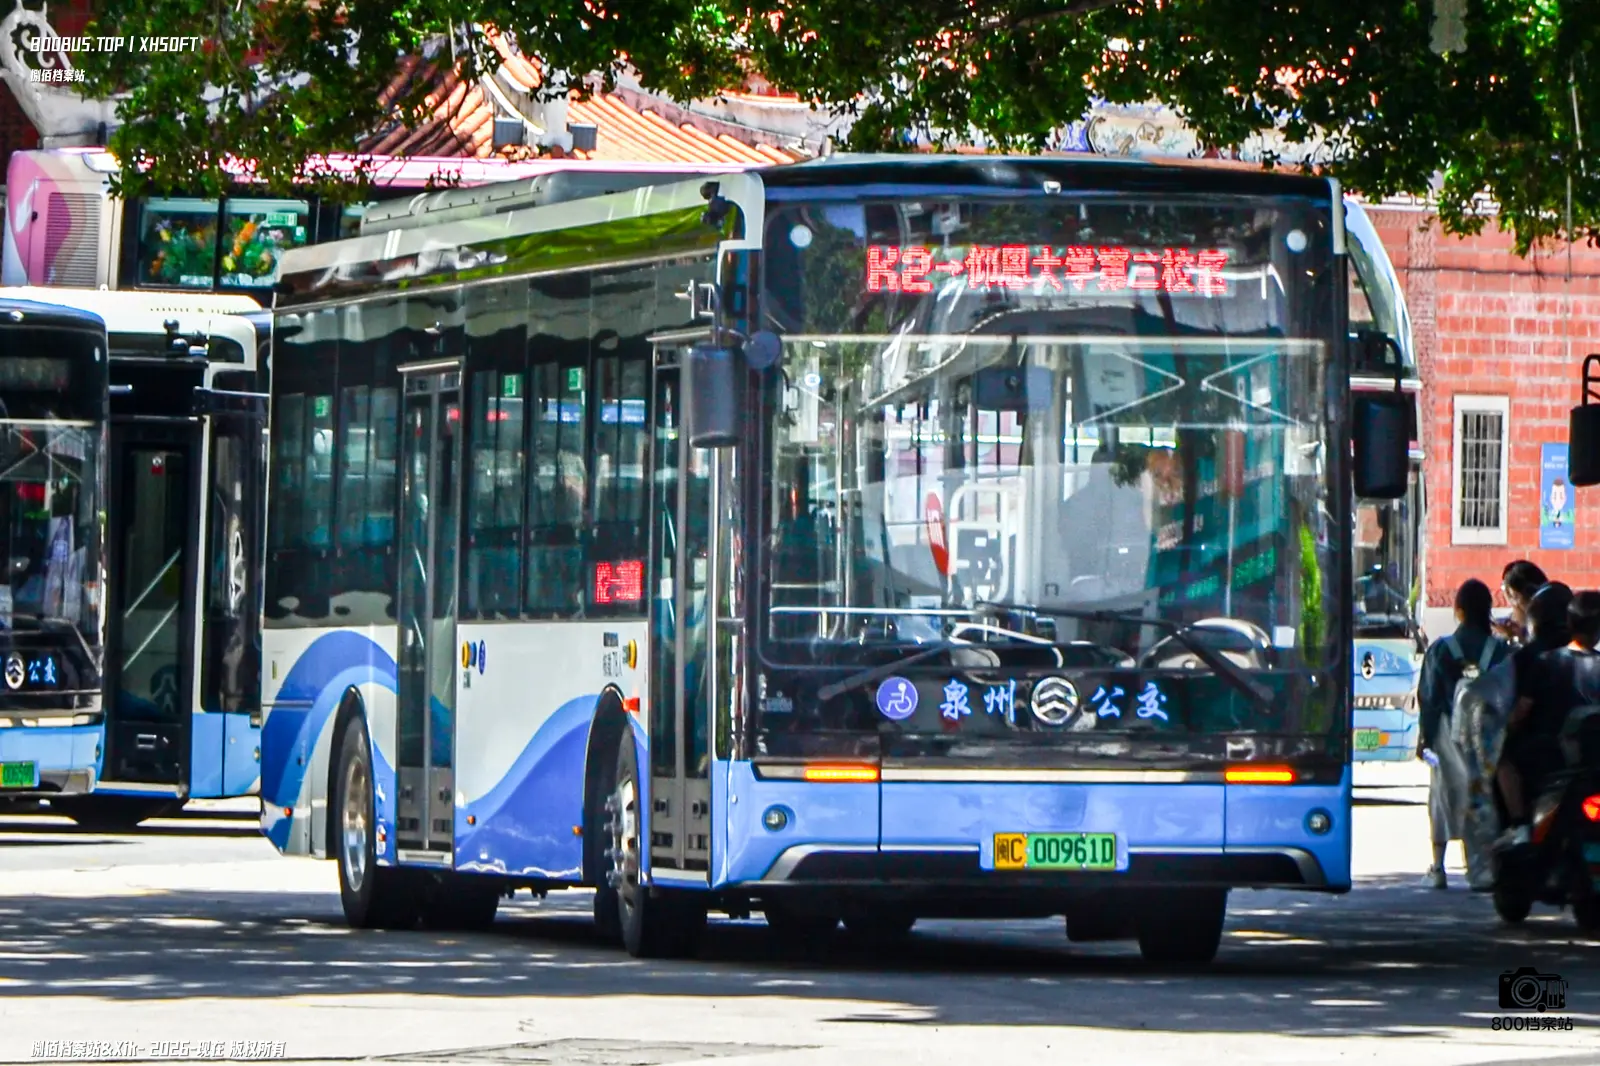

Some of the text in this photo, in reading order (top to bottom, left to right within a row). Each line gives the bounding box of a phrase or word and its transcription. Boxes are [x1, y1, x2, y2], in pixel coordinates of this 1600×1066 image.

[867, 245, 934, 293] K2
[939, 678, 1170, 722] 泉州 公交
[1033, 837, 1114, 864] 00961D
